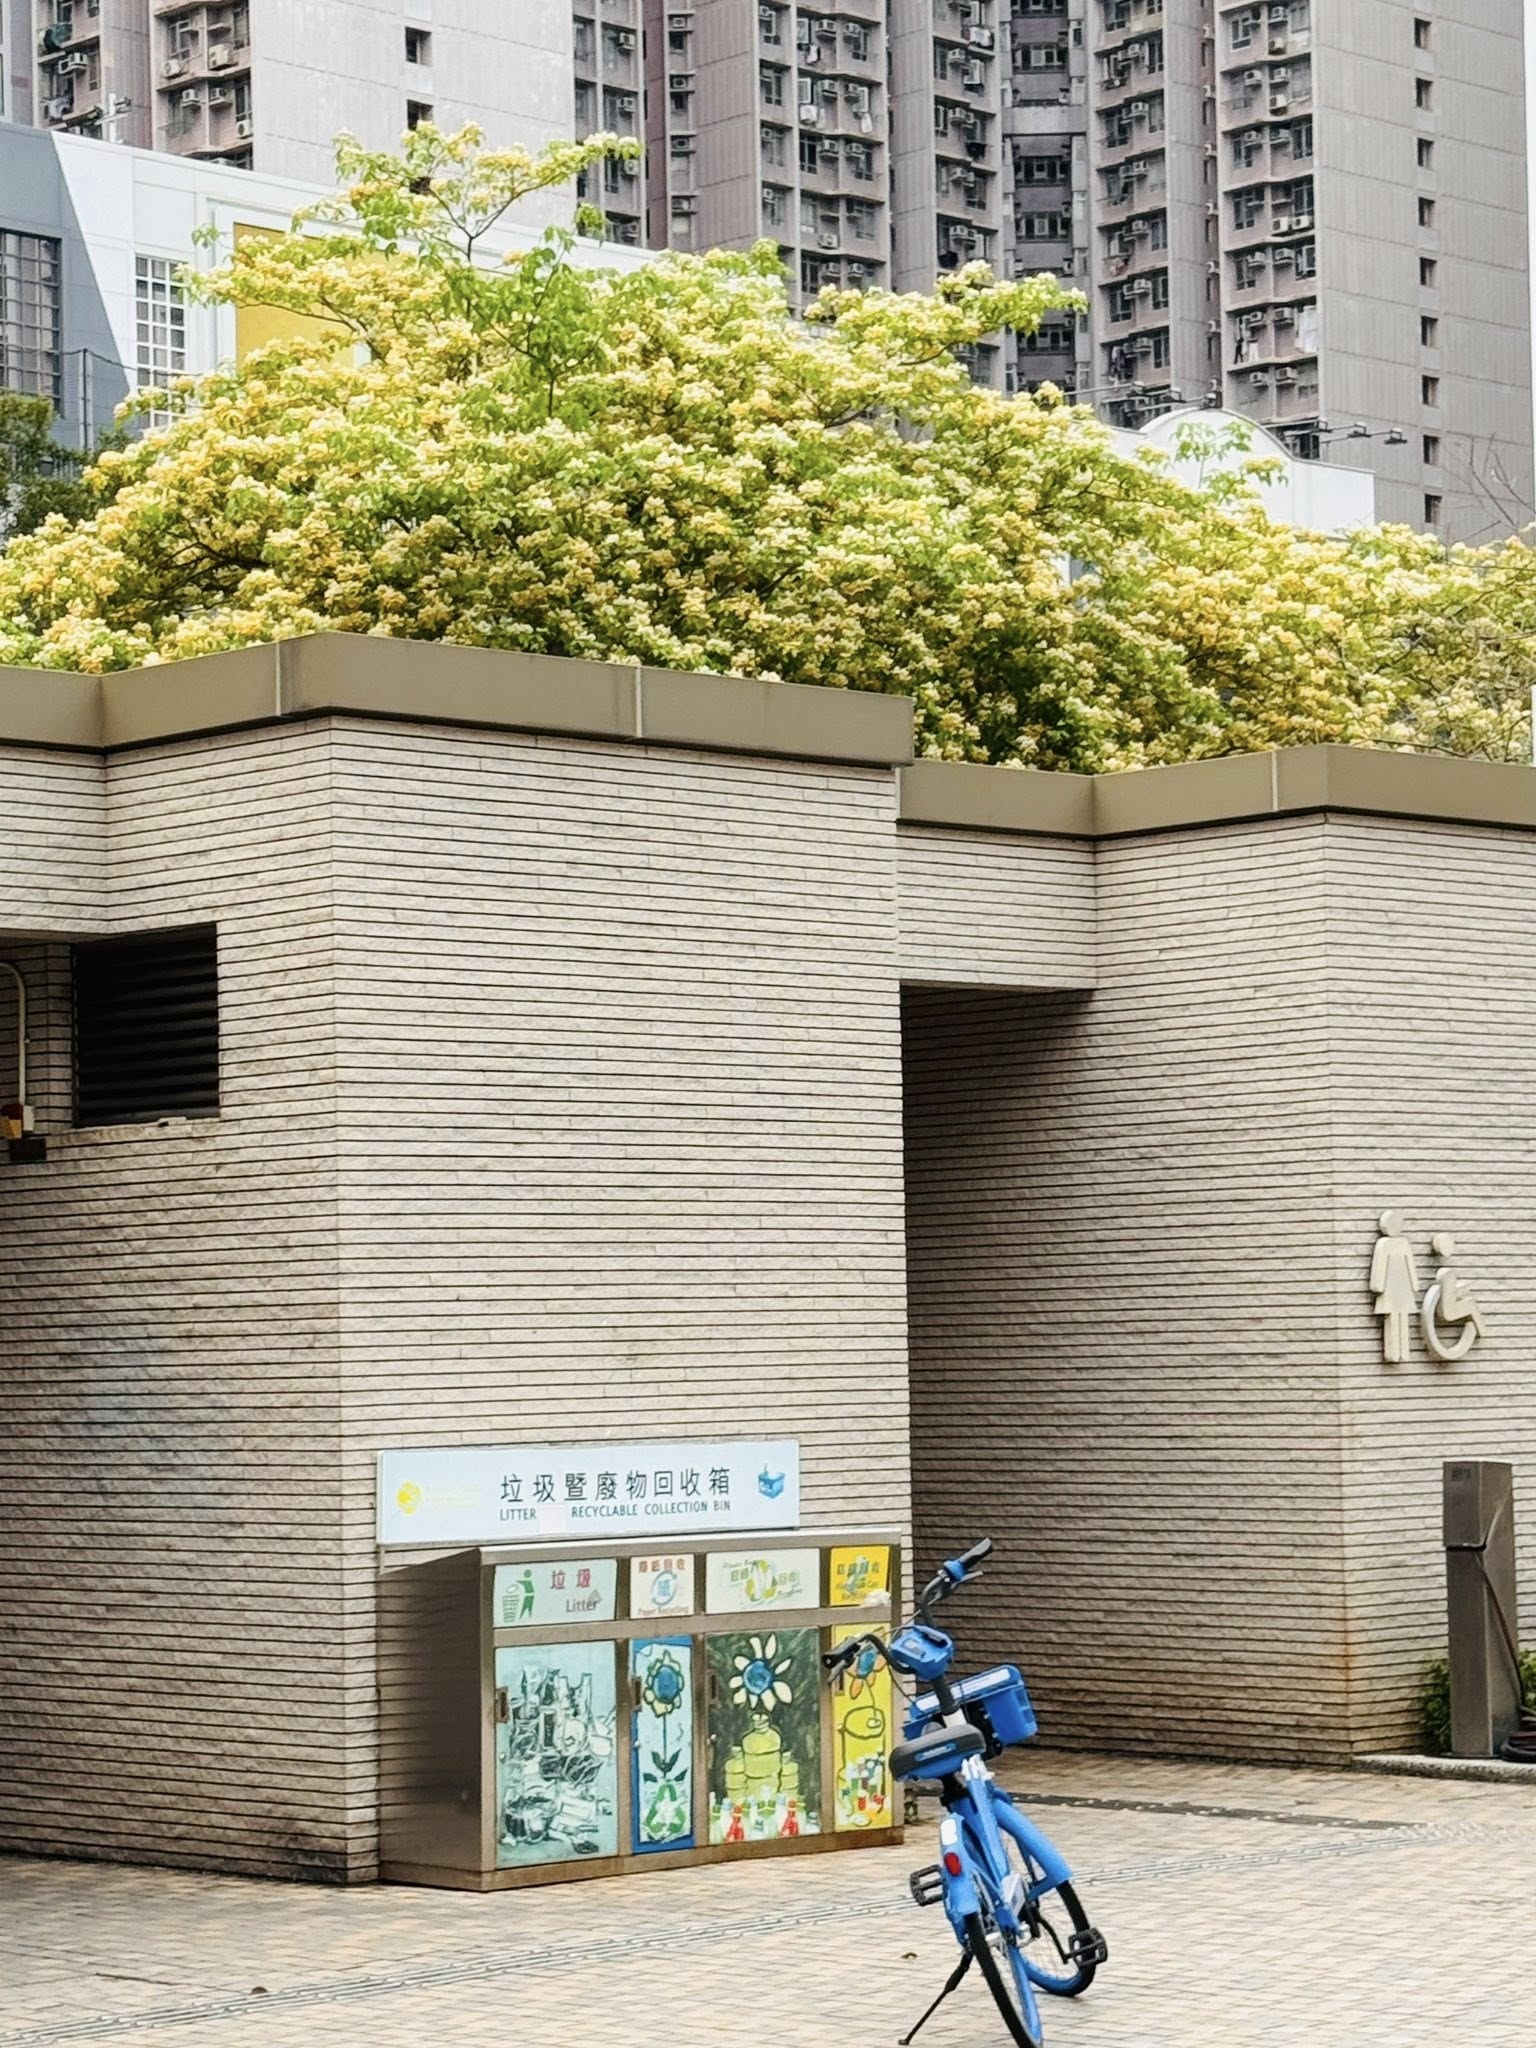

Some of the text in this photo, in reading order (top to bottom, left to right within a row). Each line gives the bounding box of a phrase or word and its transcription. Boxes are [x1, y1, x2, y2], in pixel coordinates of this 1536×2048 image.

[501, 1467, 730, 1502] 垃圾暨廢物回收箱
[500, 1500, 730, 1520] LITTER RECYCLABLE COLLECTION BIN
[550, 1568, 591, 1590] 垃圾
[565, 1598, 600, 1613] Litter
